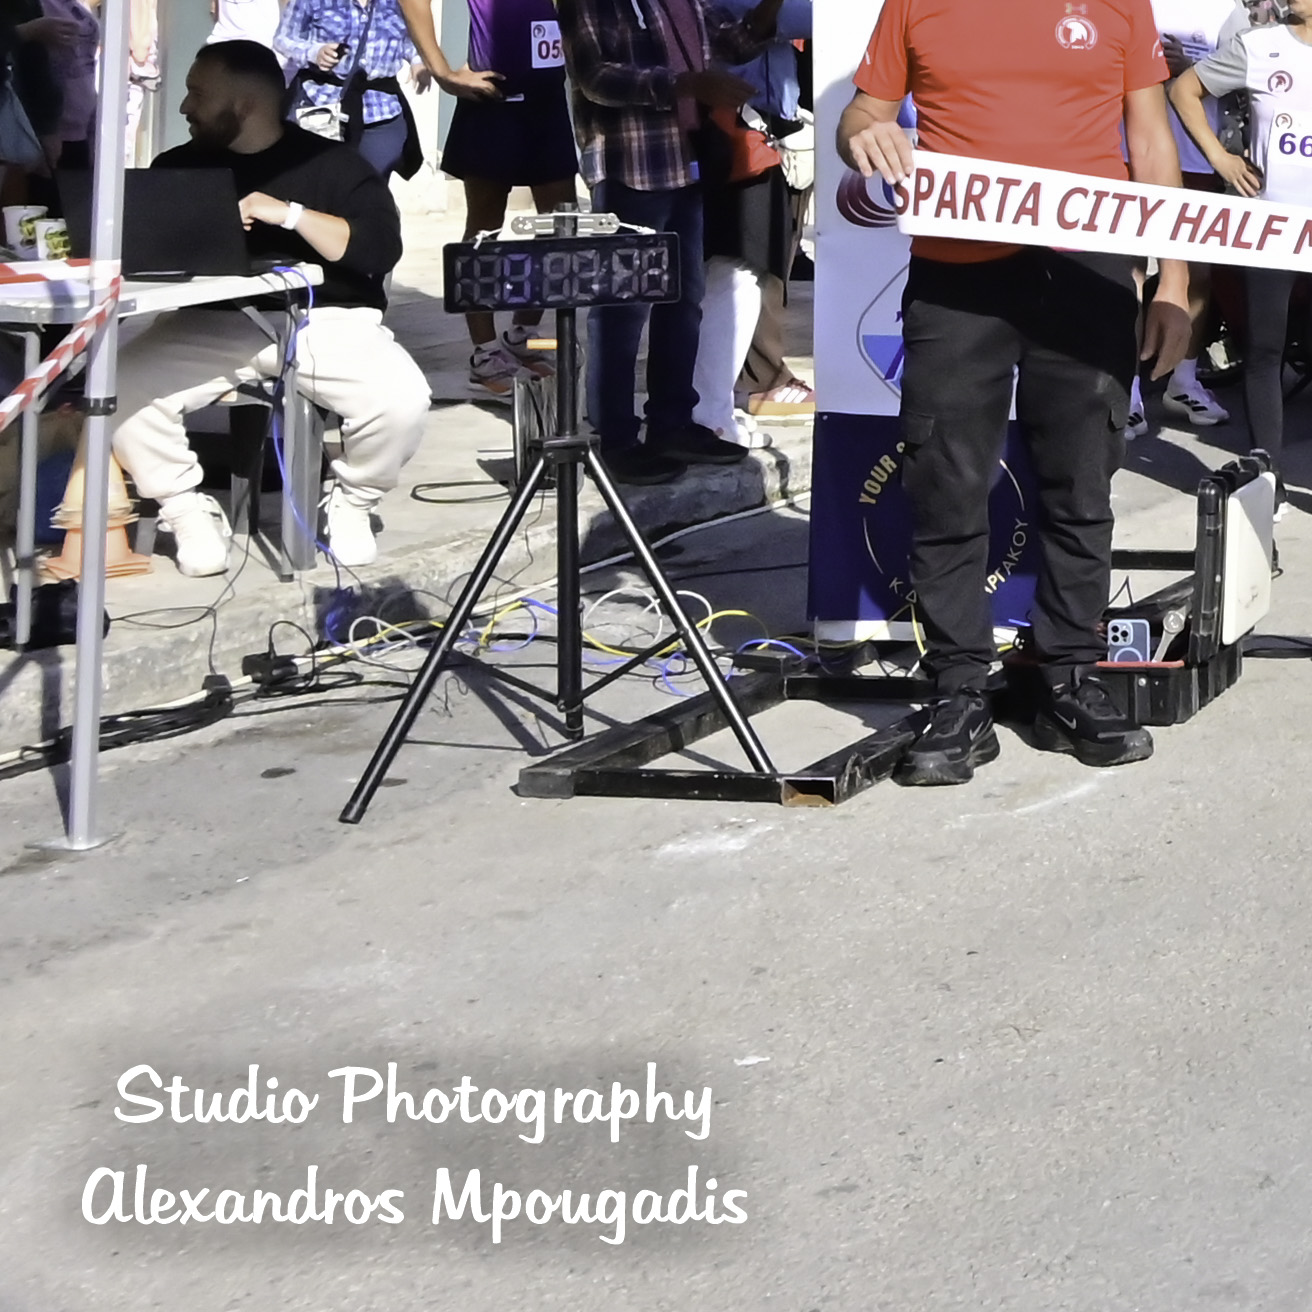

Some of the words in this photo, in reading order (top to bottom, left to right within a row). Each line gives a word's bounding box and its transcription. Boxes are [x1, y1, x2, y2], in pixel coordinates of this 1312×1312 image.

[537, 39, 562, 60] 05
[895, 167, 1042, 226] SPARTA
[1057, 187, 1166, 237] CITY
[1171, 202, 1289, 251] HALF
[858, 454, 898, 506] YOUR
